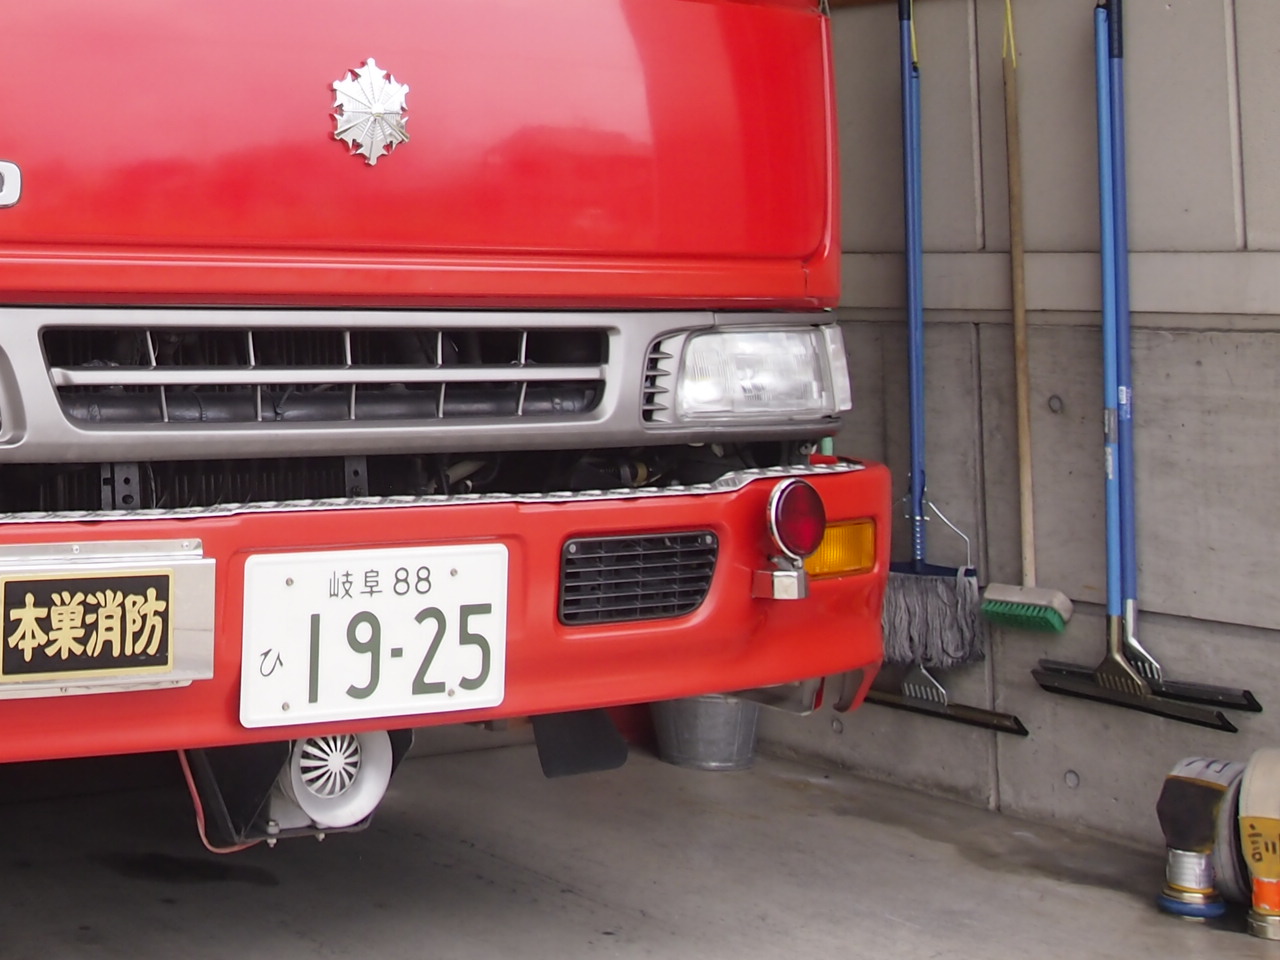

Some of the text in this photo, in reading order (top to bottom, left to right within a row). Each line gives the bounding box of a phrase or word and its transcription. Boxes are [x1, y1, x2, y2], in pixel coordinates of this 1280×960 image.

[7, 586, 166, 662] 本巣消防
[259, 603, 492, 704] ひ 19-25
